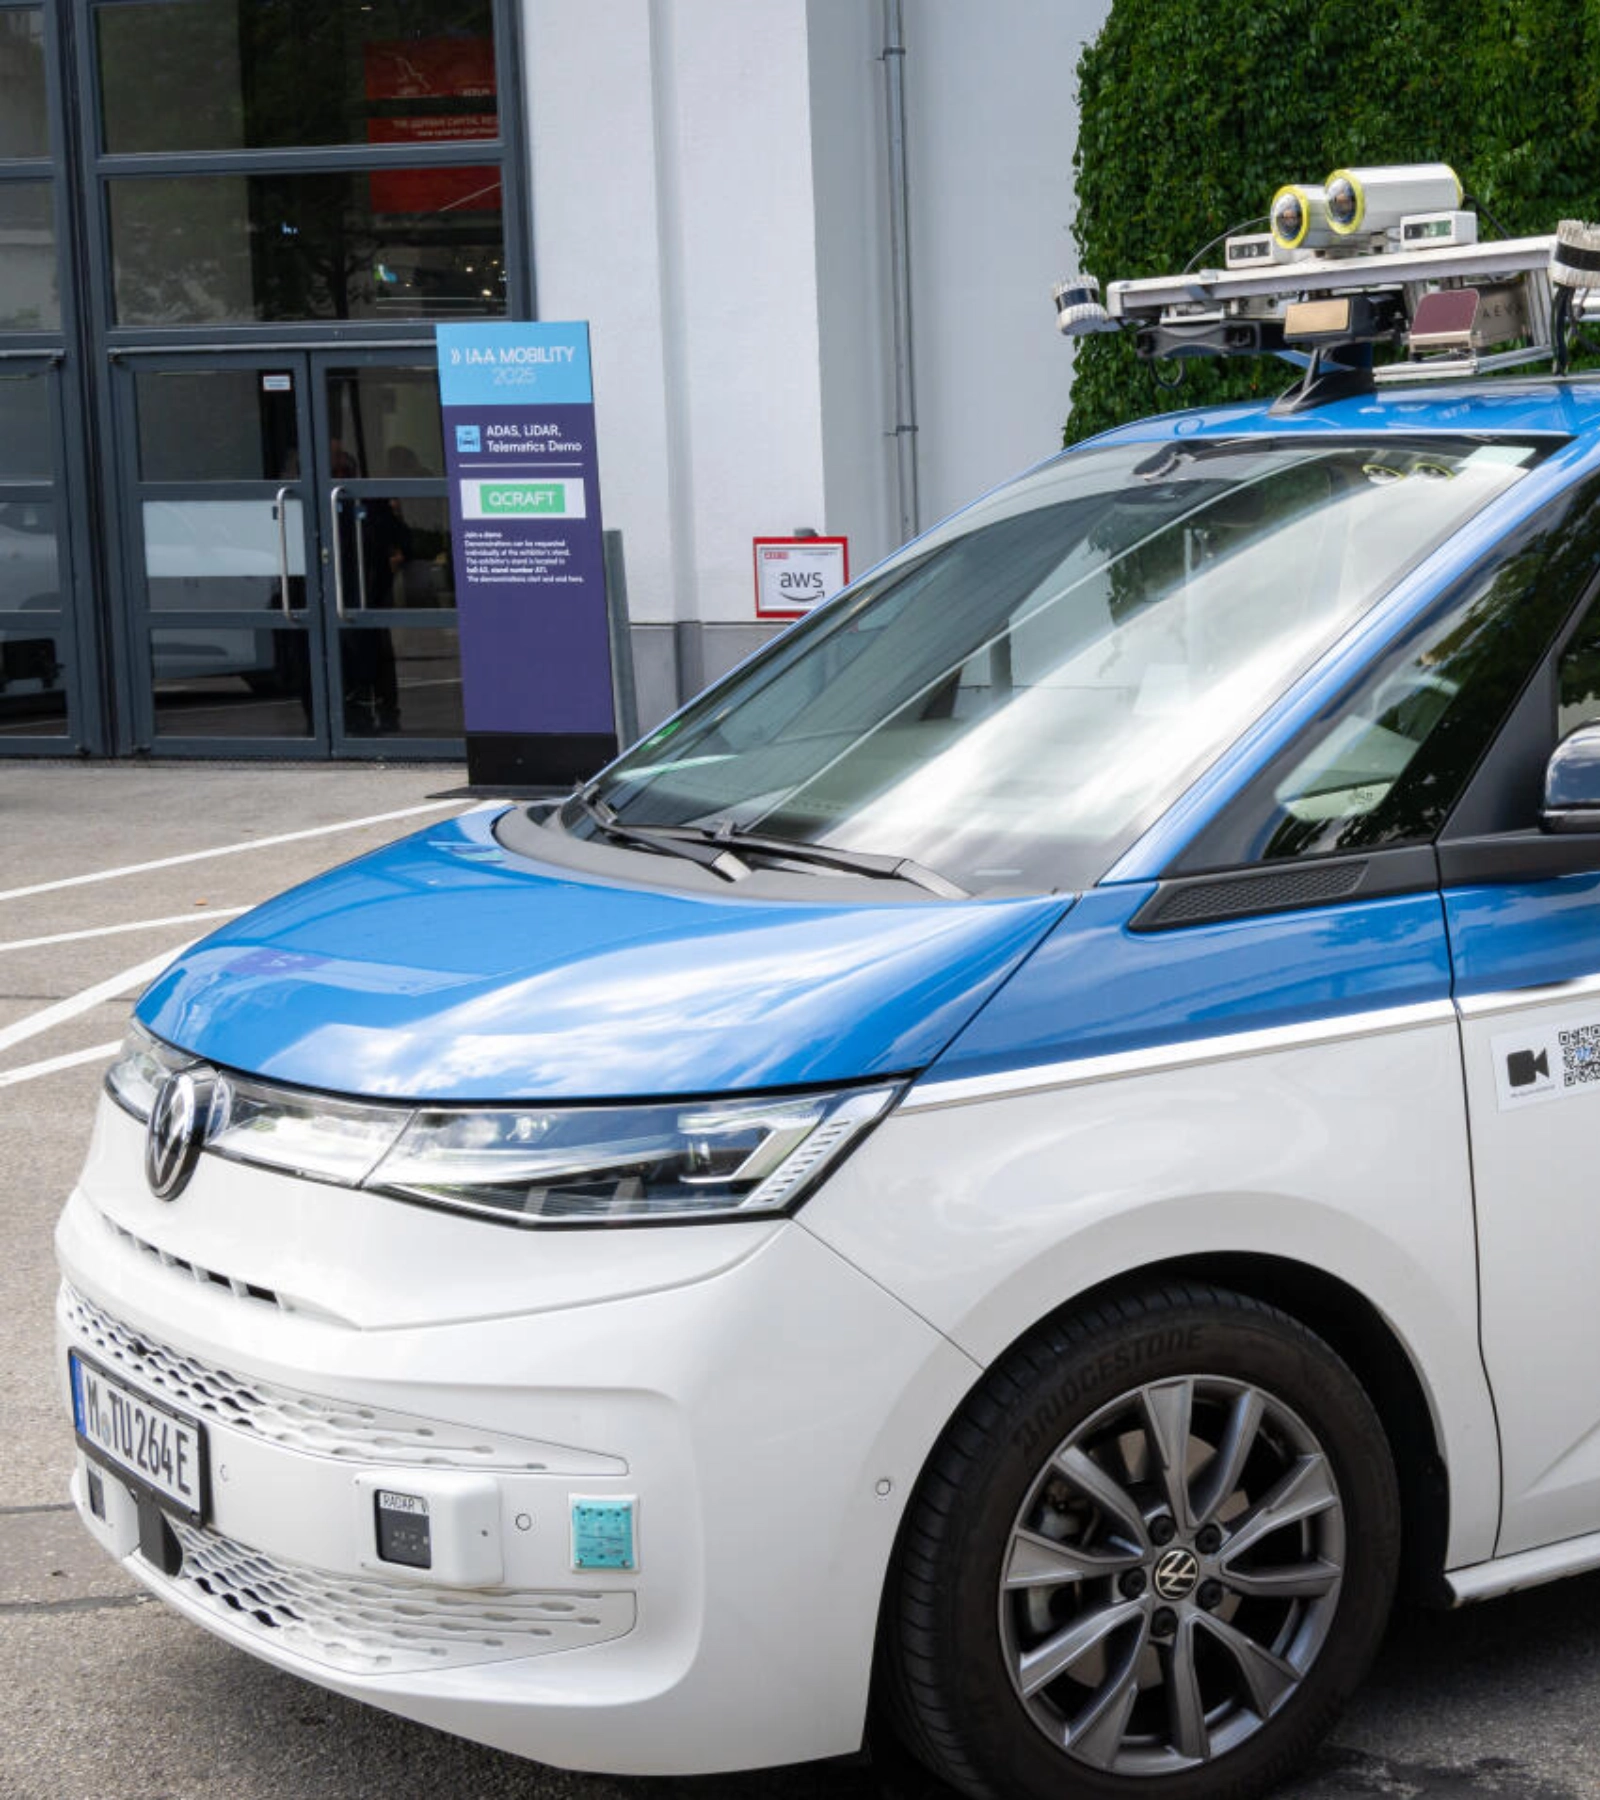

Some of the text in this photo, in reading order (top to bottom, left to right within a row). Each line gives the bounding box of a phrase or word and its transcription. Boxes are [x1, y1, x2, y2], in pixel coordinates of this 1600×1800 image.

[465, 346, 576, 365] IAA MOBILITY
[493, 366, 537, 385] 2025
[486, 425, 522, 438] ADAS,
[487, 440, 583, 453] Telematics Demo
[488, 491, 556, 507] QCRAFT
[780, 571, 824, 588] aws
[1012, 1325, 1203, 1449] BRIDGESTONE
[383, 1494, 415, 1511] RADAR
